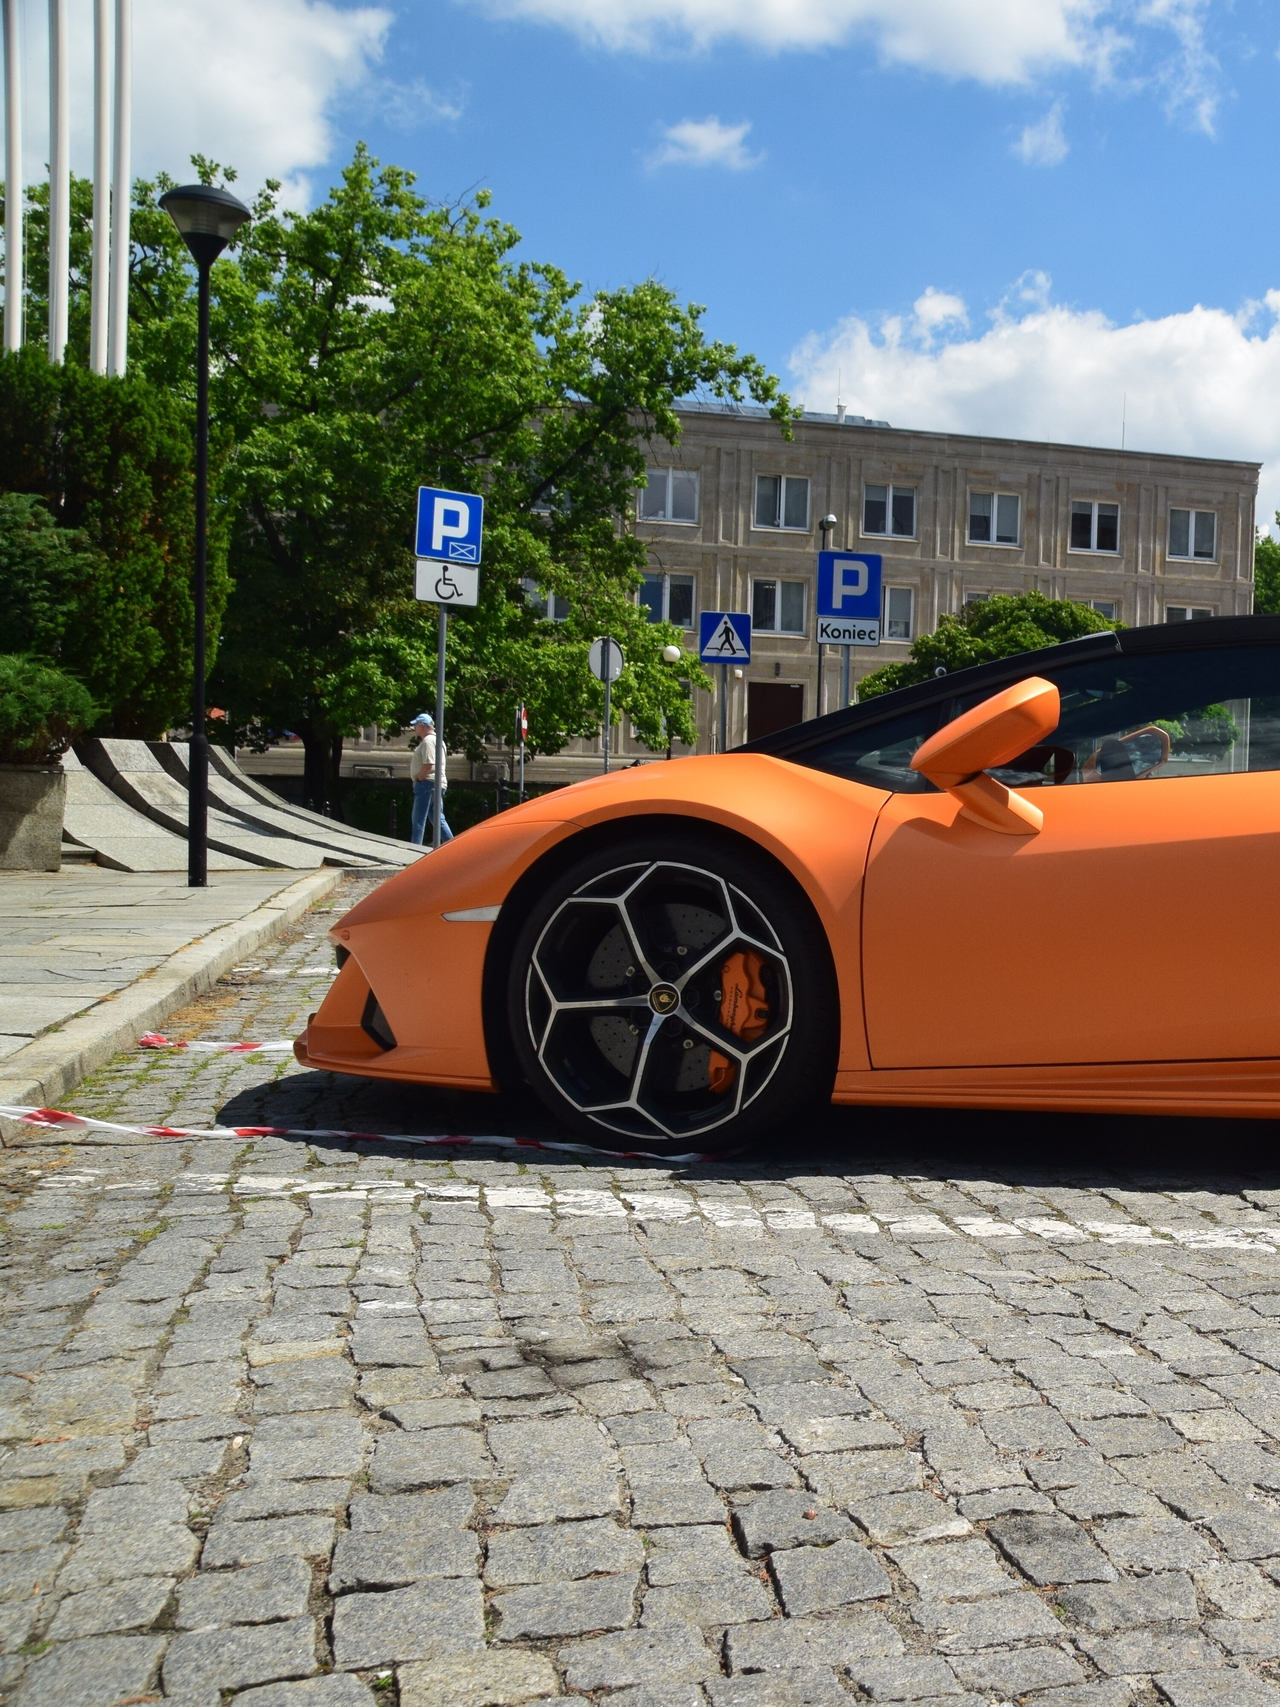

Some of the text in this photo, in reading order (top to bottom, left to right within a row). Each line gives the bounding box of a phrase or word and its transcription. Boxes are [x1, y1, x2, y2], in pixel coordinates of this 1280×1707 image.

[432, 496, 470, 551] P
[832, 558, 869, 609] P
[820, 622, 877, 641] Koniec
